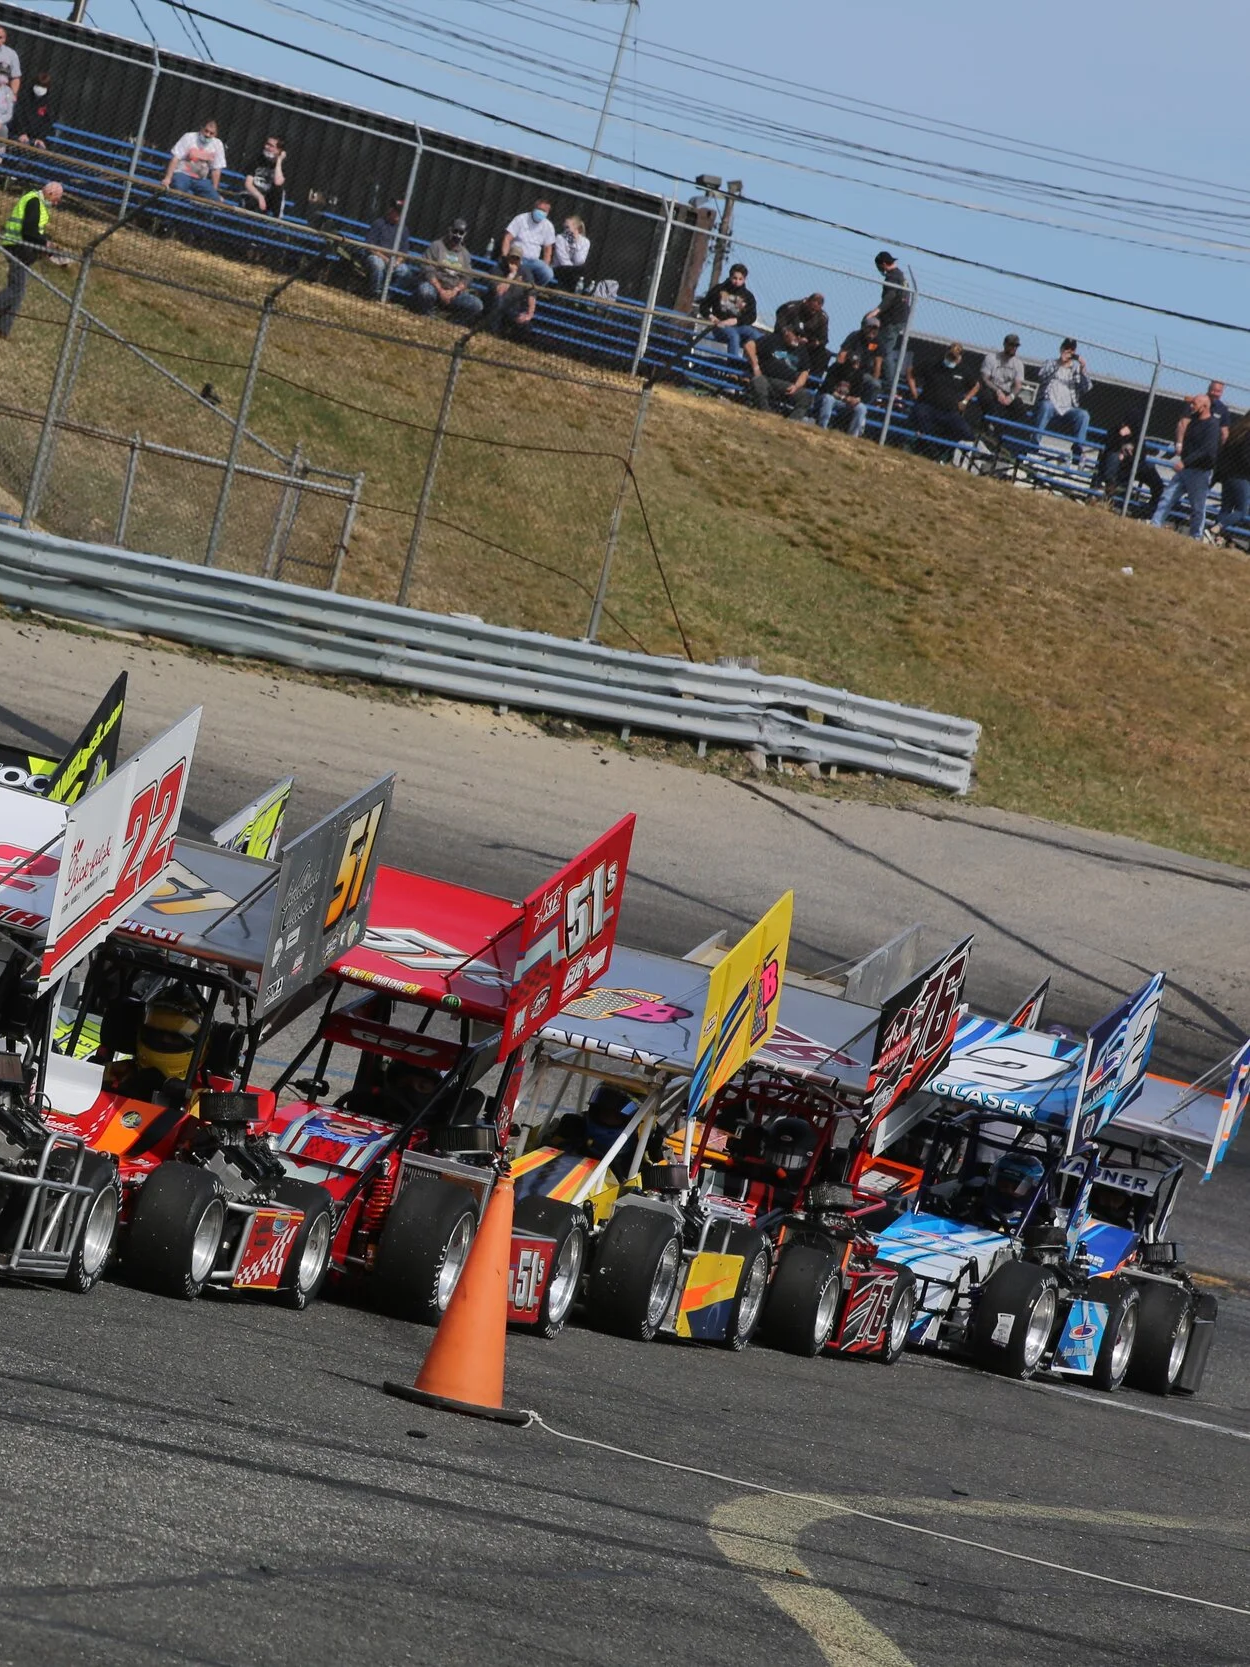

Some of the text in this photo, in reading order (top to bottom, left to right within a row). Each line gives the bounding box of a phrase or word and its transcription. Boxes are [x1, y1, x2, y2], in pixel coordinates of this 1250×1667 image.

[115, 755, 187, 899] 22
[322, 799, 386, 937] 51
[536, 1025, 668, 1066] AILEY
[946, 1046, 1080, 1093] 2
[1116, 998, 1160, 1093] 2
[930, 1079, 1040, 1120] GLASER
[427, 1244, 447, 1308] Hoosier
